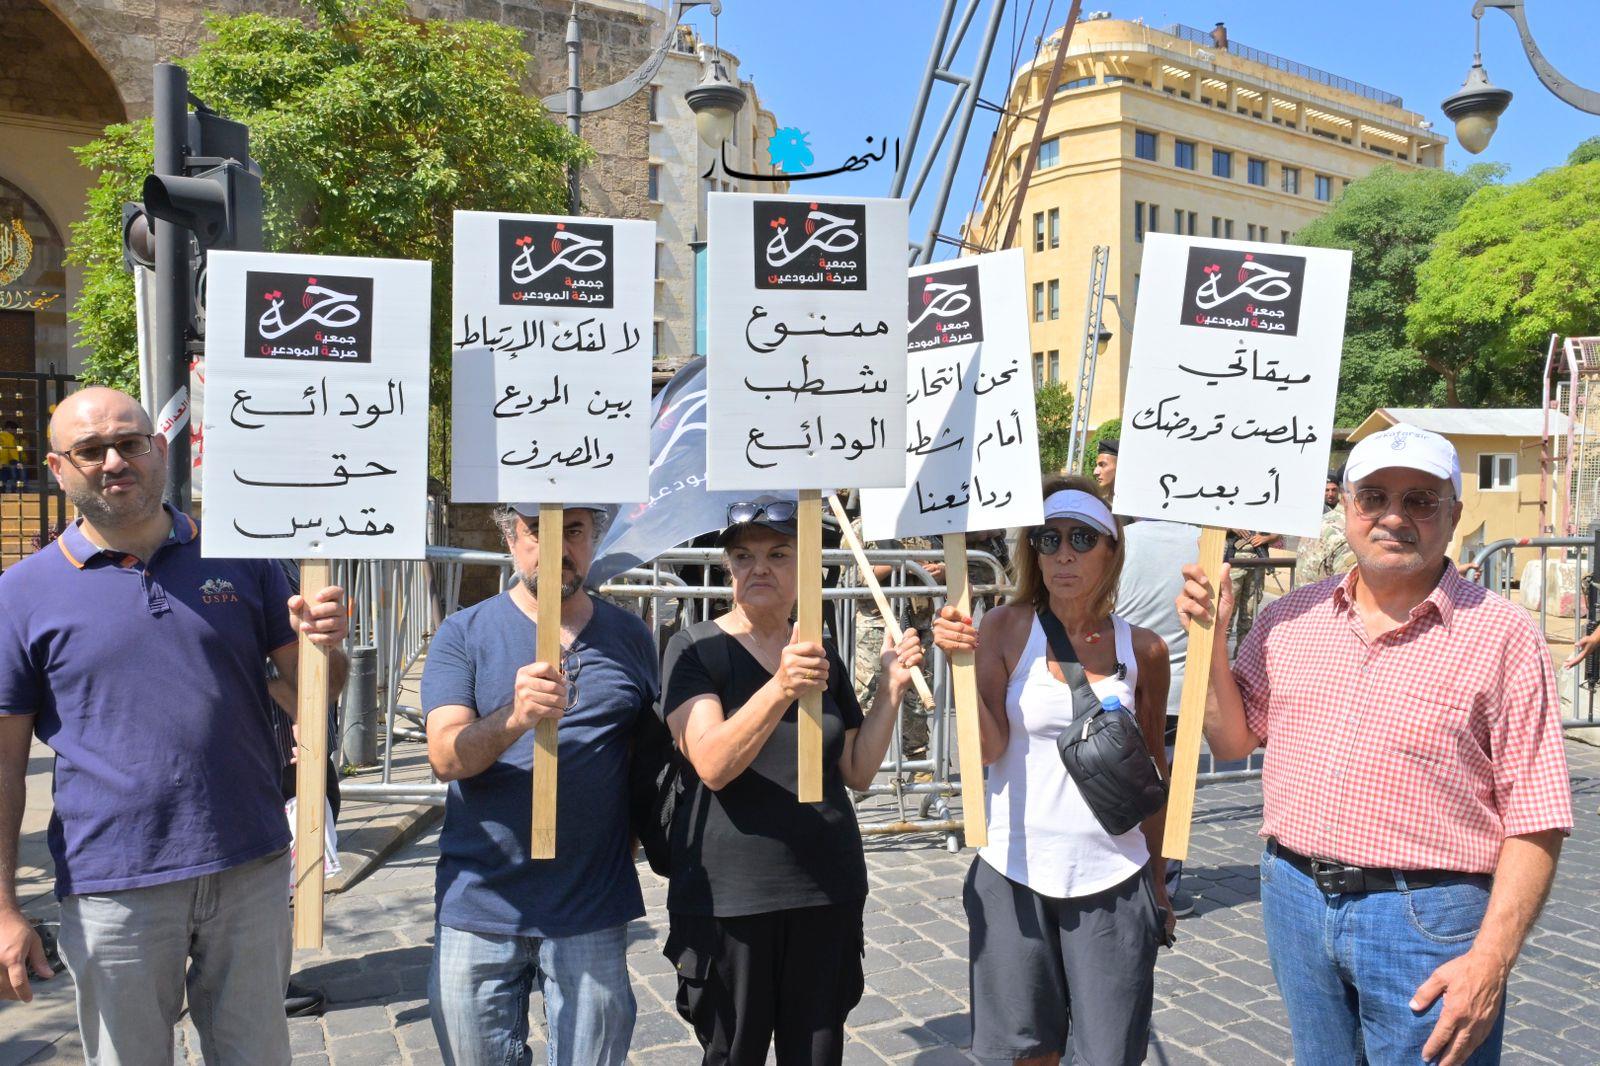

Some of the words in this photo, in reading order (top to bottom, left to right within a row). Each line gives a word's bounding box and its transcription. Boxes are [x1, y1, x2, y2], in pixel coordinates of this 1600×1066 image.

[818, 258, 857, 270] جمعية
[564, 276, 604, 288] جمعية
[767, 271, 823, 283] المودعين
[826, 271, 858, 283] صرخة
[512, 290, 569, 301] المودعين
[572, 290, 605, 302] صرخة
[1246, 304, 1285, 318] جمعية
[935, 320, 970, 333] جمعية
[1195, 312, 1249, 327] المودعين
[1250, 317, 1286, 331] صرخة
[745, 304, 889, 354] ممنوع
[314, 331, 356, 345] جمعية
[611, 322, 641, 355] لا
[908, 336, 941, 350] المودع
[941, 332, 973, 344] صرخة
[260, 344, 319, 357] المودعين
[320, 345, 359, 359] صرخة
[973, 358, 1019, 396] نحن
[1178, 348, 1312, 391] ميقاتي
[744, 355, 888, 404] شطب
[230, 375, 405, 429] الودائع
[493, 374, 569, 419] المودع
[587, 389, 633, 420] بين
[1131, 394, 1226, 441] قروضك
[745, 415, 886, 469] الودائع
[977, 408, 1023, 462] أمام
[233, 453, 398, 488] حق
[1244, 467, 1280, 506] أو
[915, 475, 1013, 515] ودائعنا
[233, 506, 395, 539] مقدس
[202, 594, 239, 605] USPA
